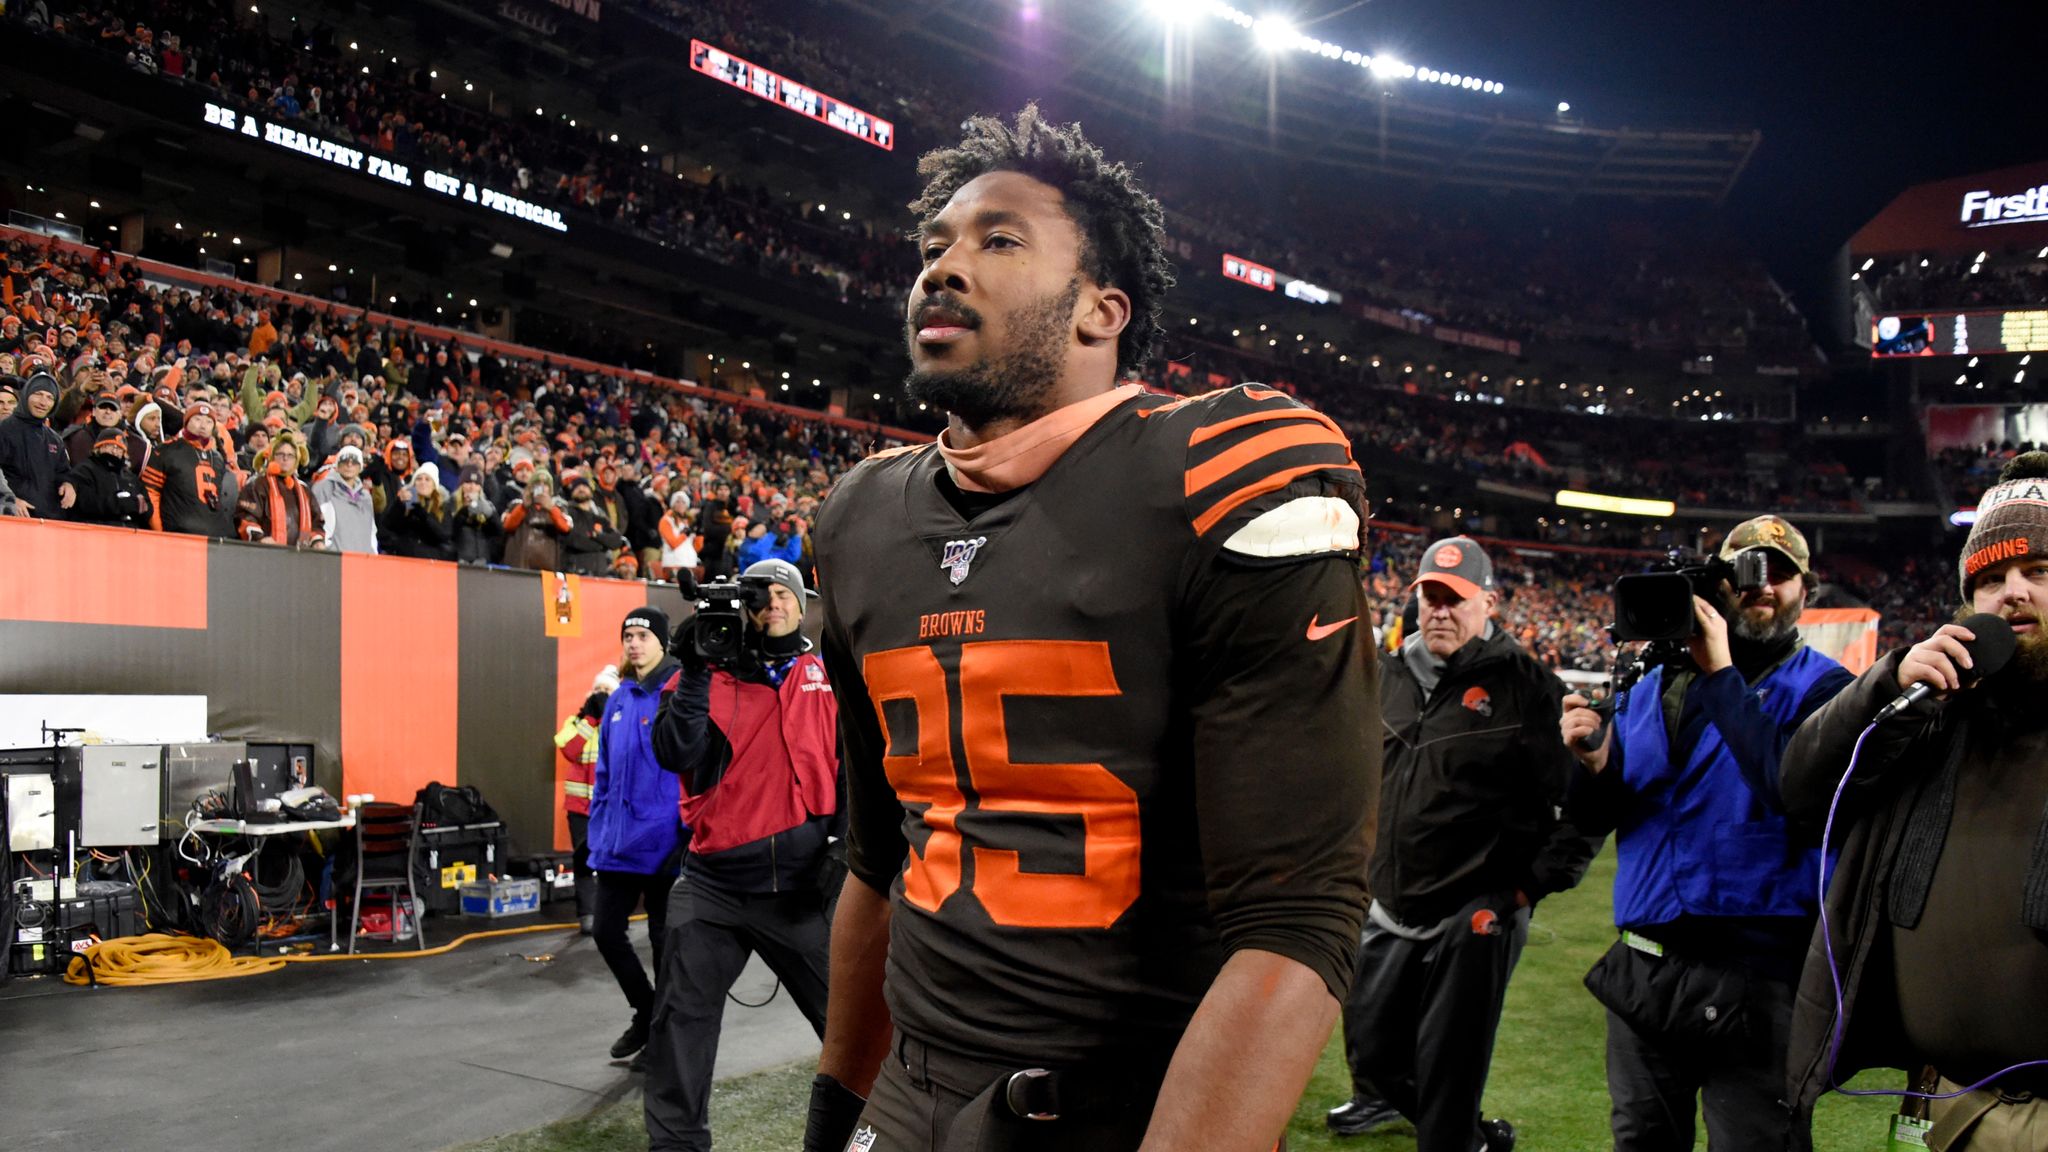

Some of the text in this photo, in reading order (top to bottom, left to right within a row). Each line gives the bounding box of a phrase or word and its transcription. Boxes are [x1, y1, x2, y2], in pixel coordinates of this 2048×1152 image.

[204, 102, 568, 232] BE A HEALTHY FAN. GET A PHYSICAL.
[1965, 537, 2029, 574] BROWNS
[919, 609, 985, 639] BROWNS
[863, 640, 1143, 929] 95
